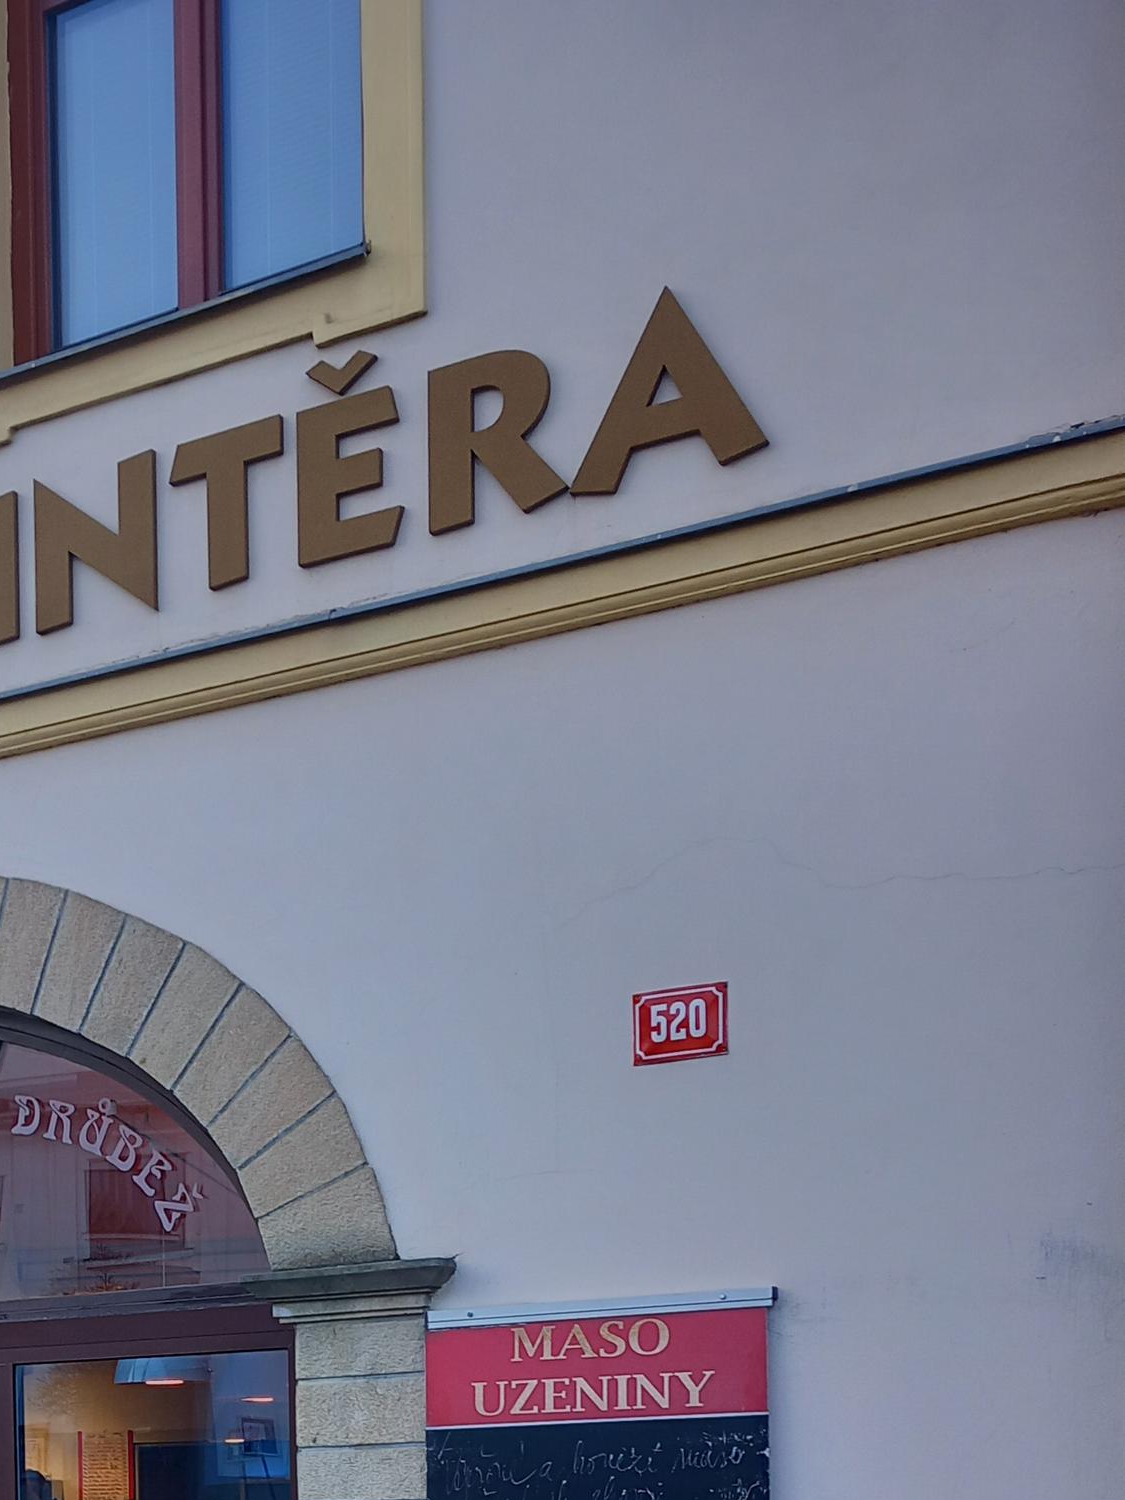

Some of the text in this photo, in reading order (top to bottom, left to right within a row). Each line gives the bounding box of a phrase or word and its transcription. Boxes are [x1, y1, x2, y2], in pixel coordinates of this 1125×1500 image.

[650, 998, 707, 1043] 520
[11, 1094, 207, 1234] DRŮBEŽ
[510, 1317, 671, 1363] MASO
[471, 1370, 716, 1417] UZENINY
